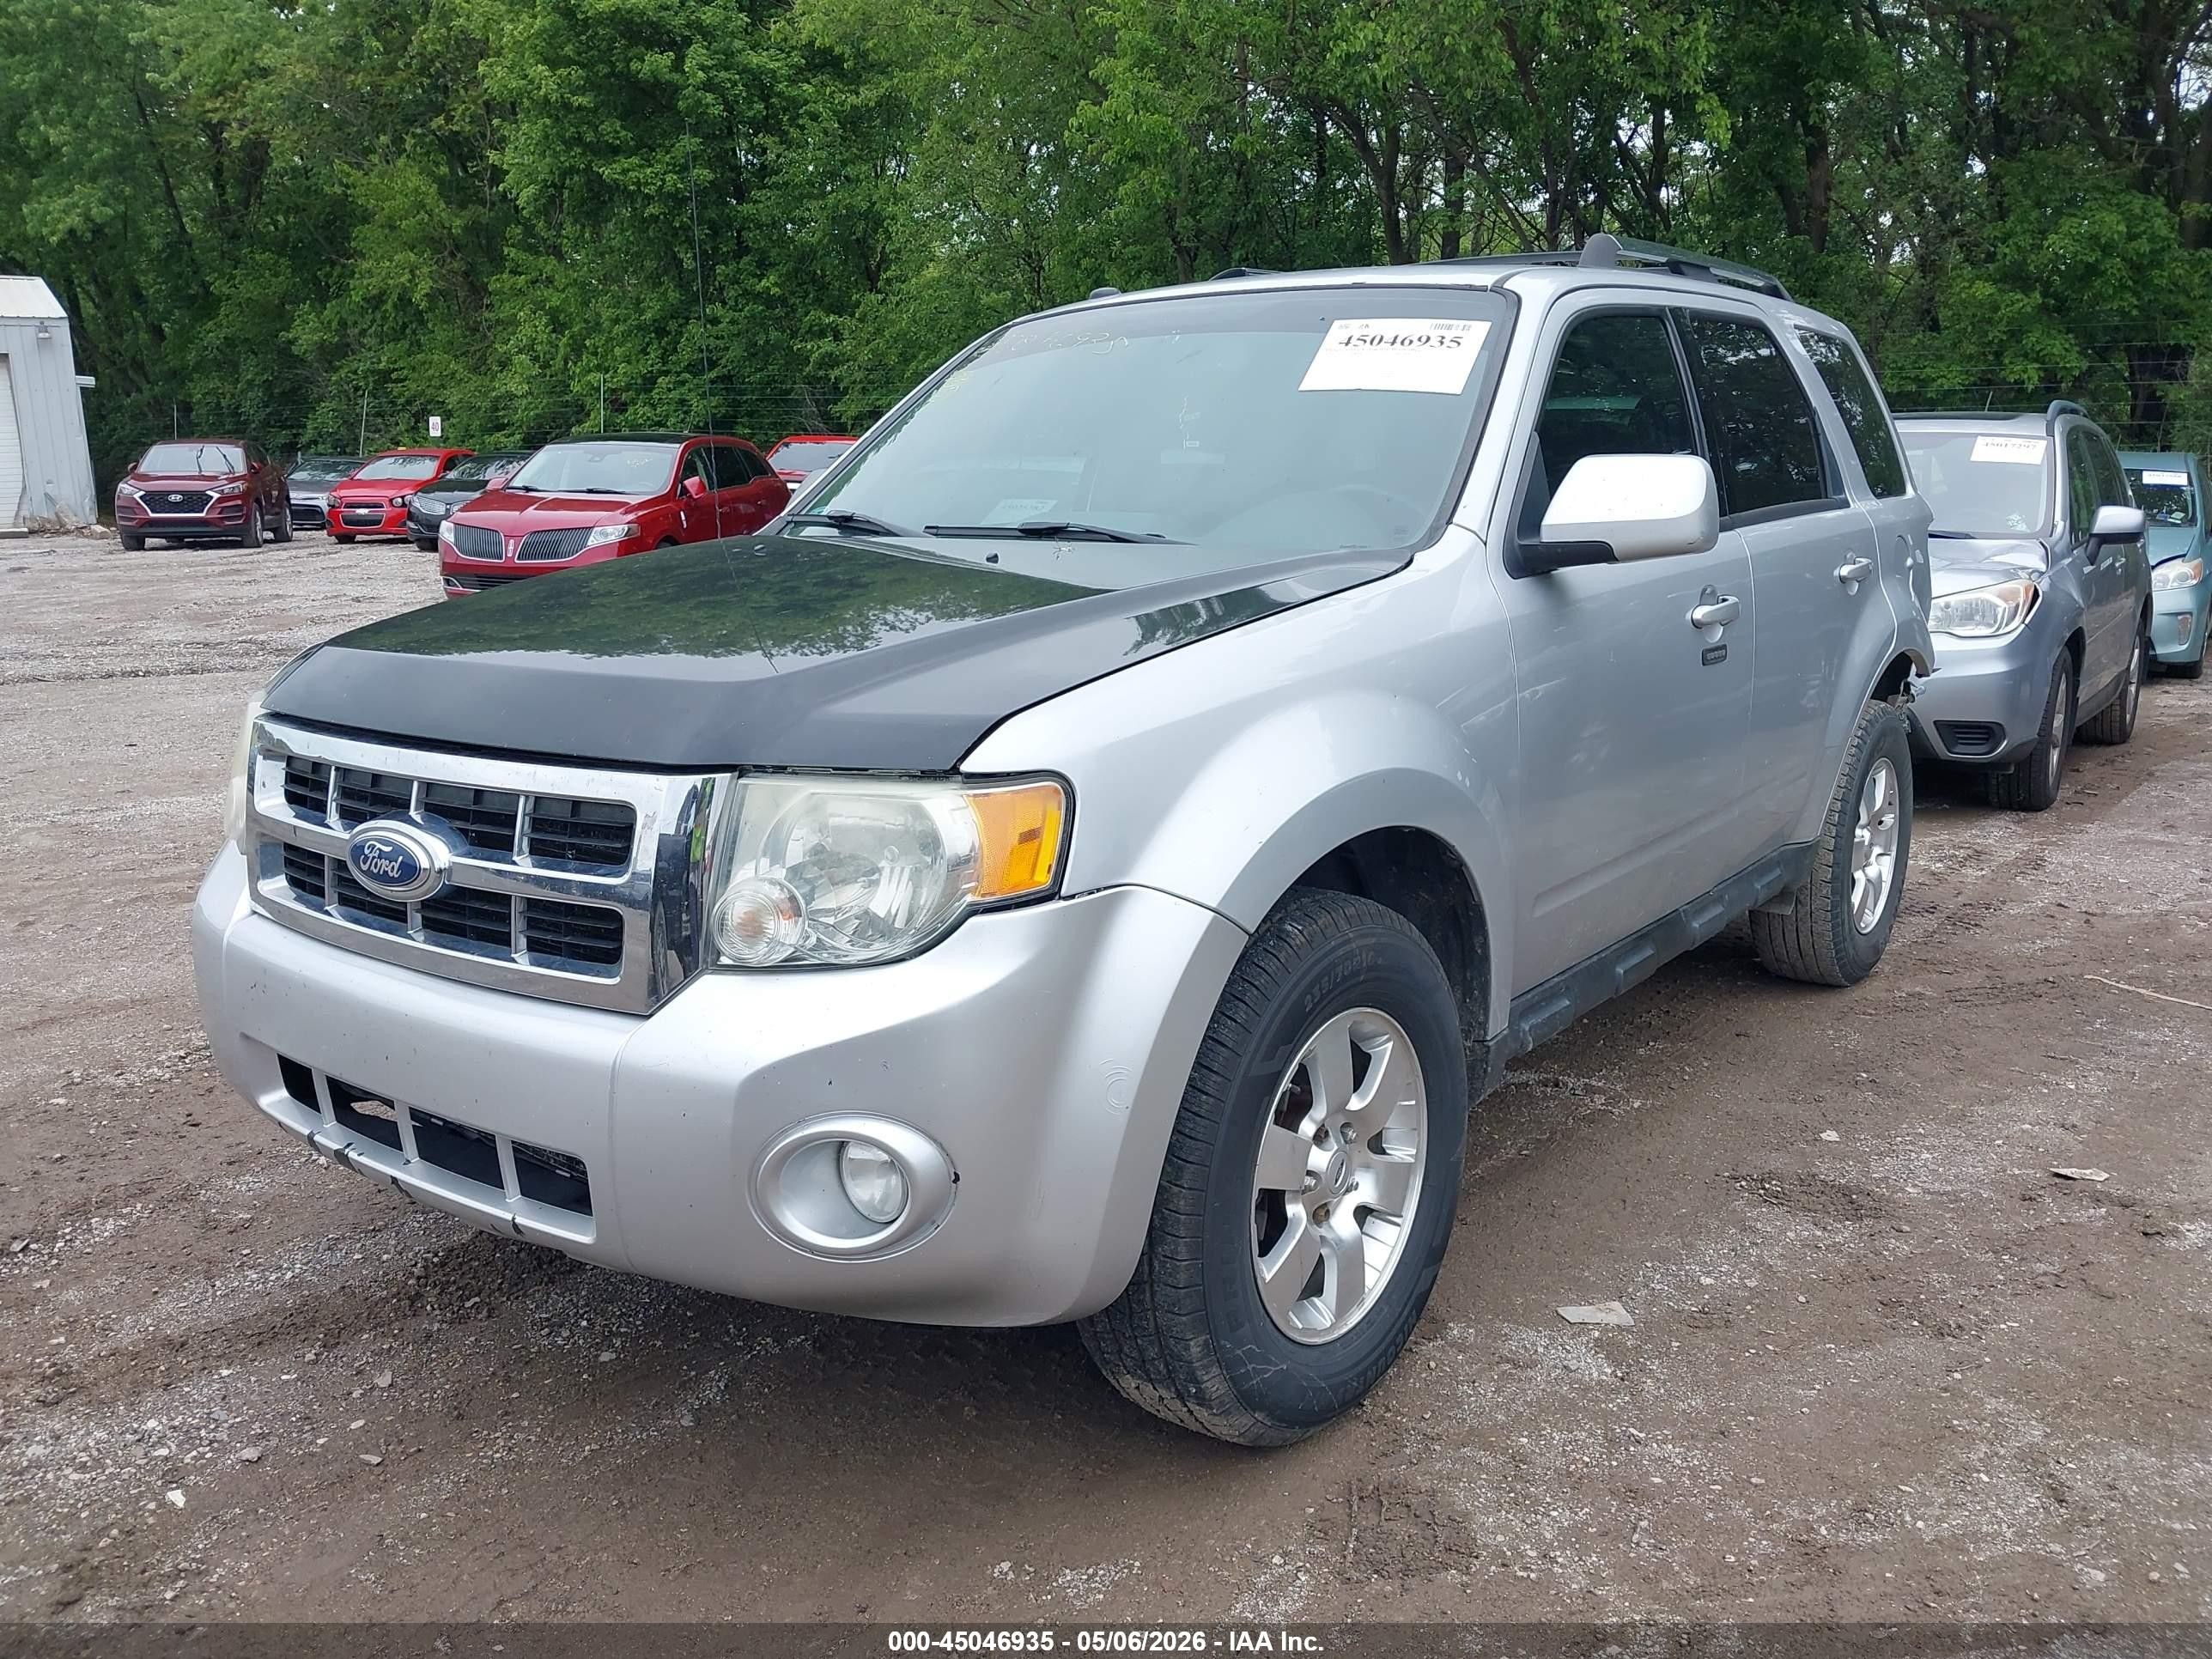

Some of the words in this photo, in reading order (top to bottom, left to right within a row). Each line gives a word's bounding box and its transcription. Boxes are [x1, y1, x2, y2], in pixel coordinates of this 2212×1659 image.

[1339, 333, 1464, 349] 45046935
[431, 422, 440, 432] 40
[359, 841, 404, 878] Ford
